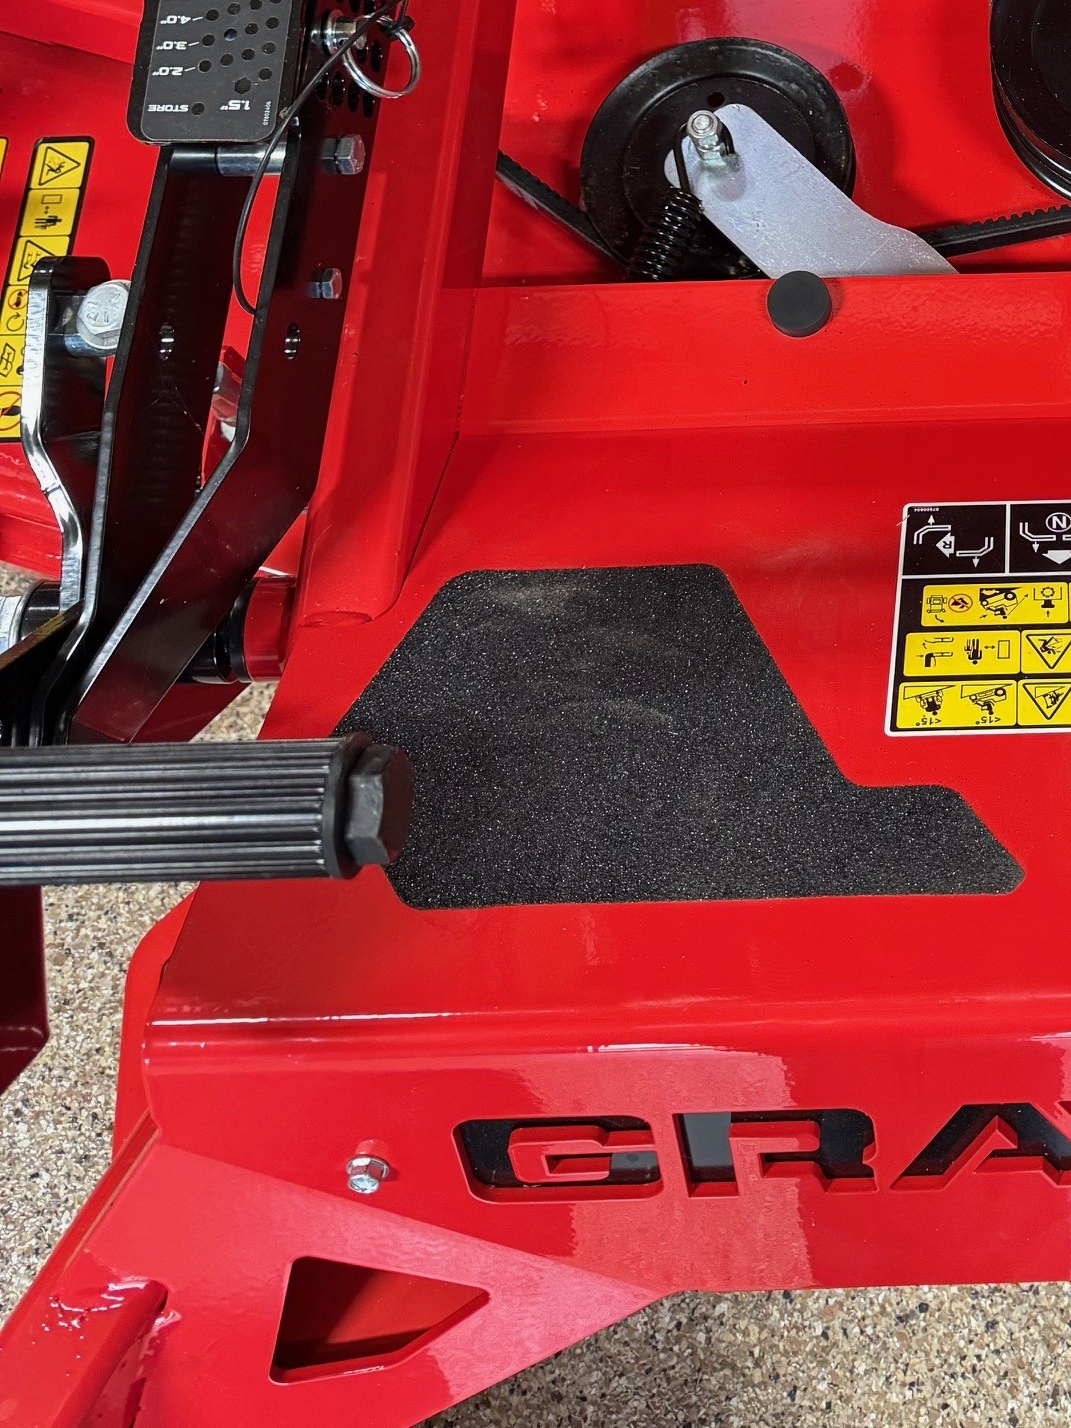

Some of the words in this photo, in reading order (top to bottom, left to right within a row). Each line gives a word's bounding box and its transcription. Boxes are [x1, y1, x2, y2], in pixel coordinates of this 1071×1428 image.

[159, 15, 192, 25] 4.0"
[155, 40, 188, 50] 3.0"
[151, 66, 184, 76] 2.0"
[147, 104, 189, 112] STORE
[220, 99, 251, 111] 1.5"
[1052, 515, 1067, 529] N
[942, 540, 952, 549] R
